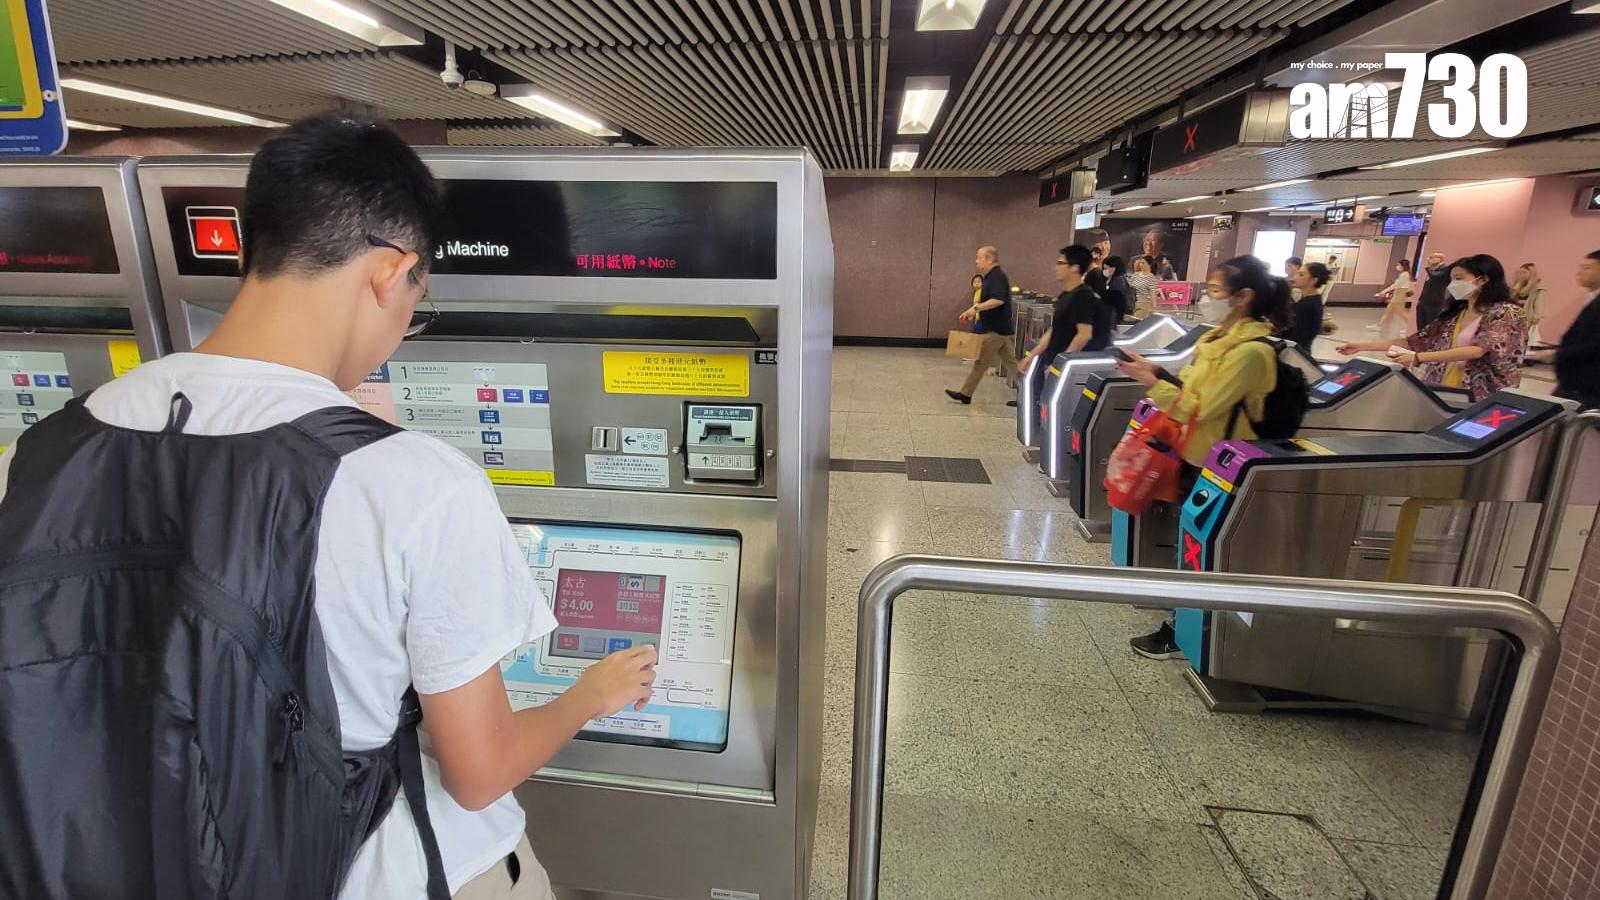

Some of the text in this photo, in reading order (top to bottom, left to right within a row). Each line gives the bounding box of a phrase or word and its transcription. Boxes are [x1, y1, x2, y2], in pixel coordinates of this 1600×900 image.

[446, 240, 509, 257] Machine
[576, 254, 637, 269] 可用紙幣
[401, 366, 408, 379] 1
[402, 387, 412, 400] 2
[405, 408, 415, 421] 3
[563, 576, 586, 588] 太古
